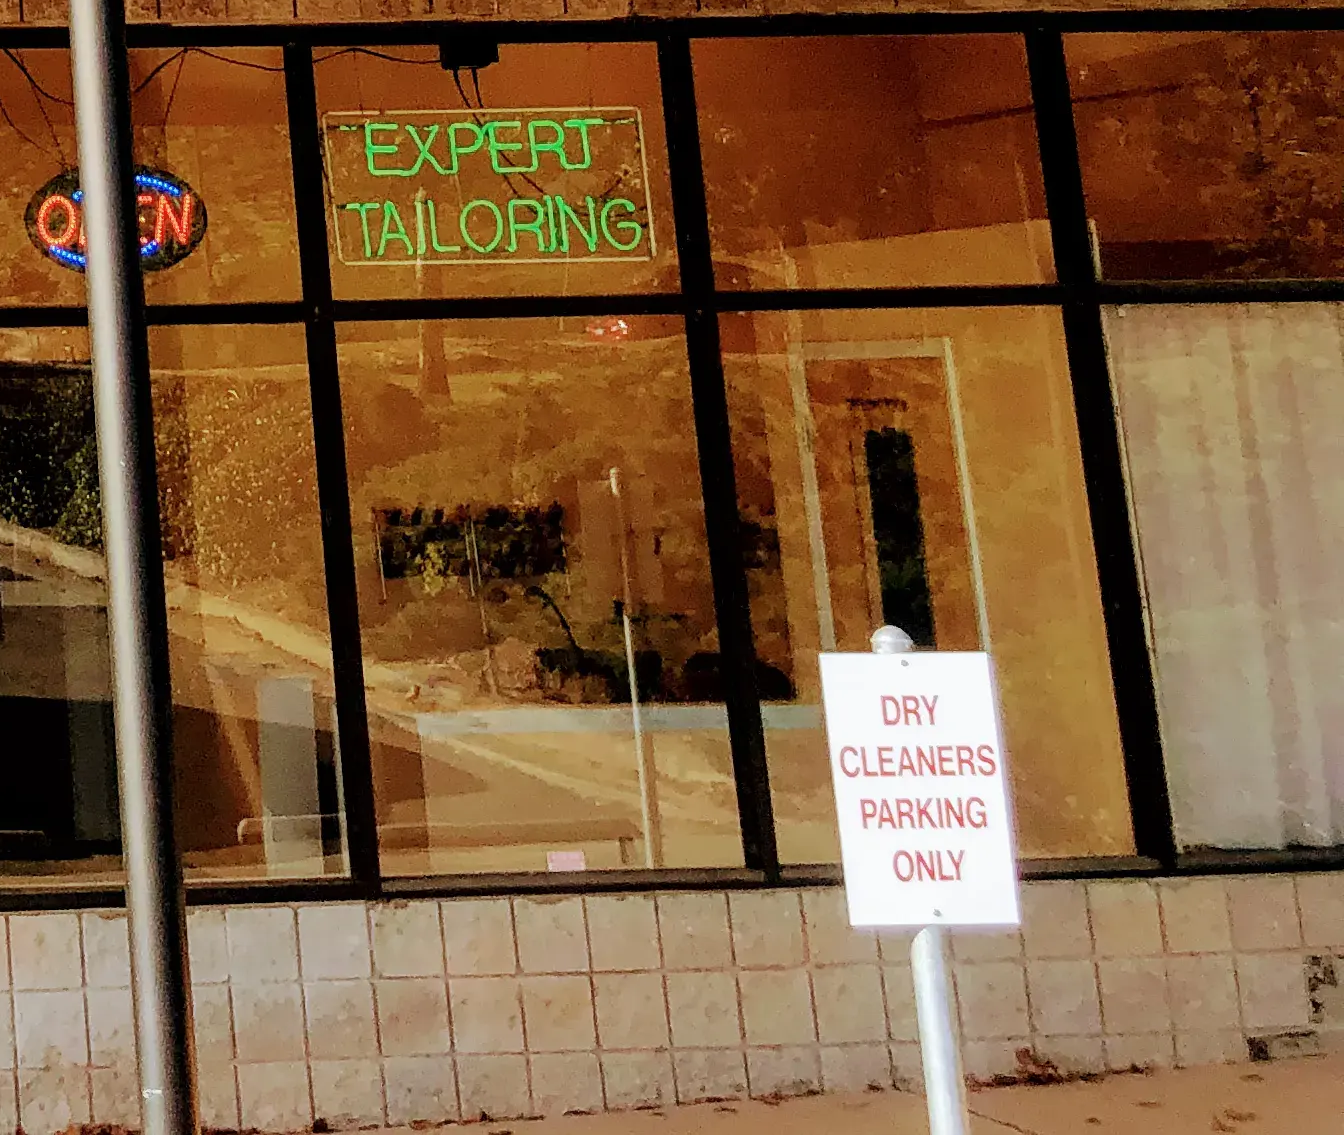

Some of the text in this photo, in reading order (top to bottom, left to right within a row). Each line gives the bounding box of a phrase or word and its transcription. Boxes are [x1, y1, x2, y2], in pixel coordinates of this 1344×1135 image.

[365, 118, 603, 177] EXPERT
[36, 193, 193, 247] ON
[343, 195, 643, 258] TAILORING
[880, 695, 938, 726] DRY
[840, 745, 996, 778] CLEANERS
[860, 797, 988, 829] PARKING
[892, 850, 965, 882] ONLY
